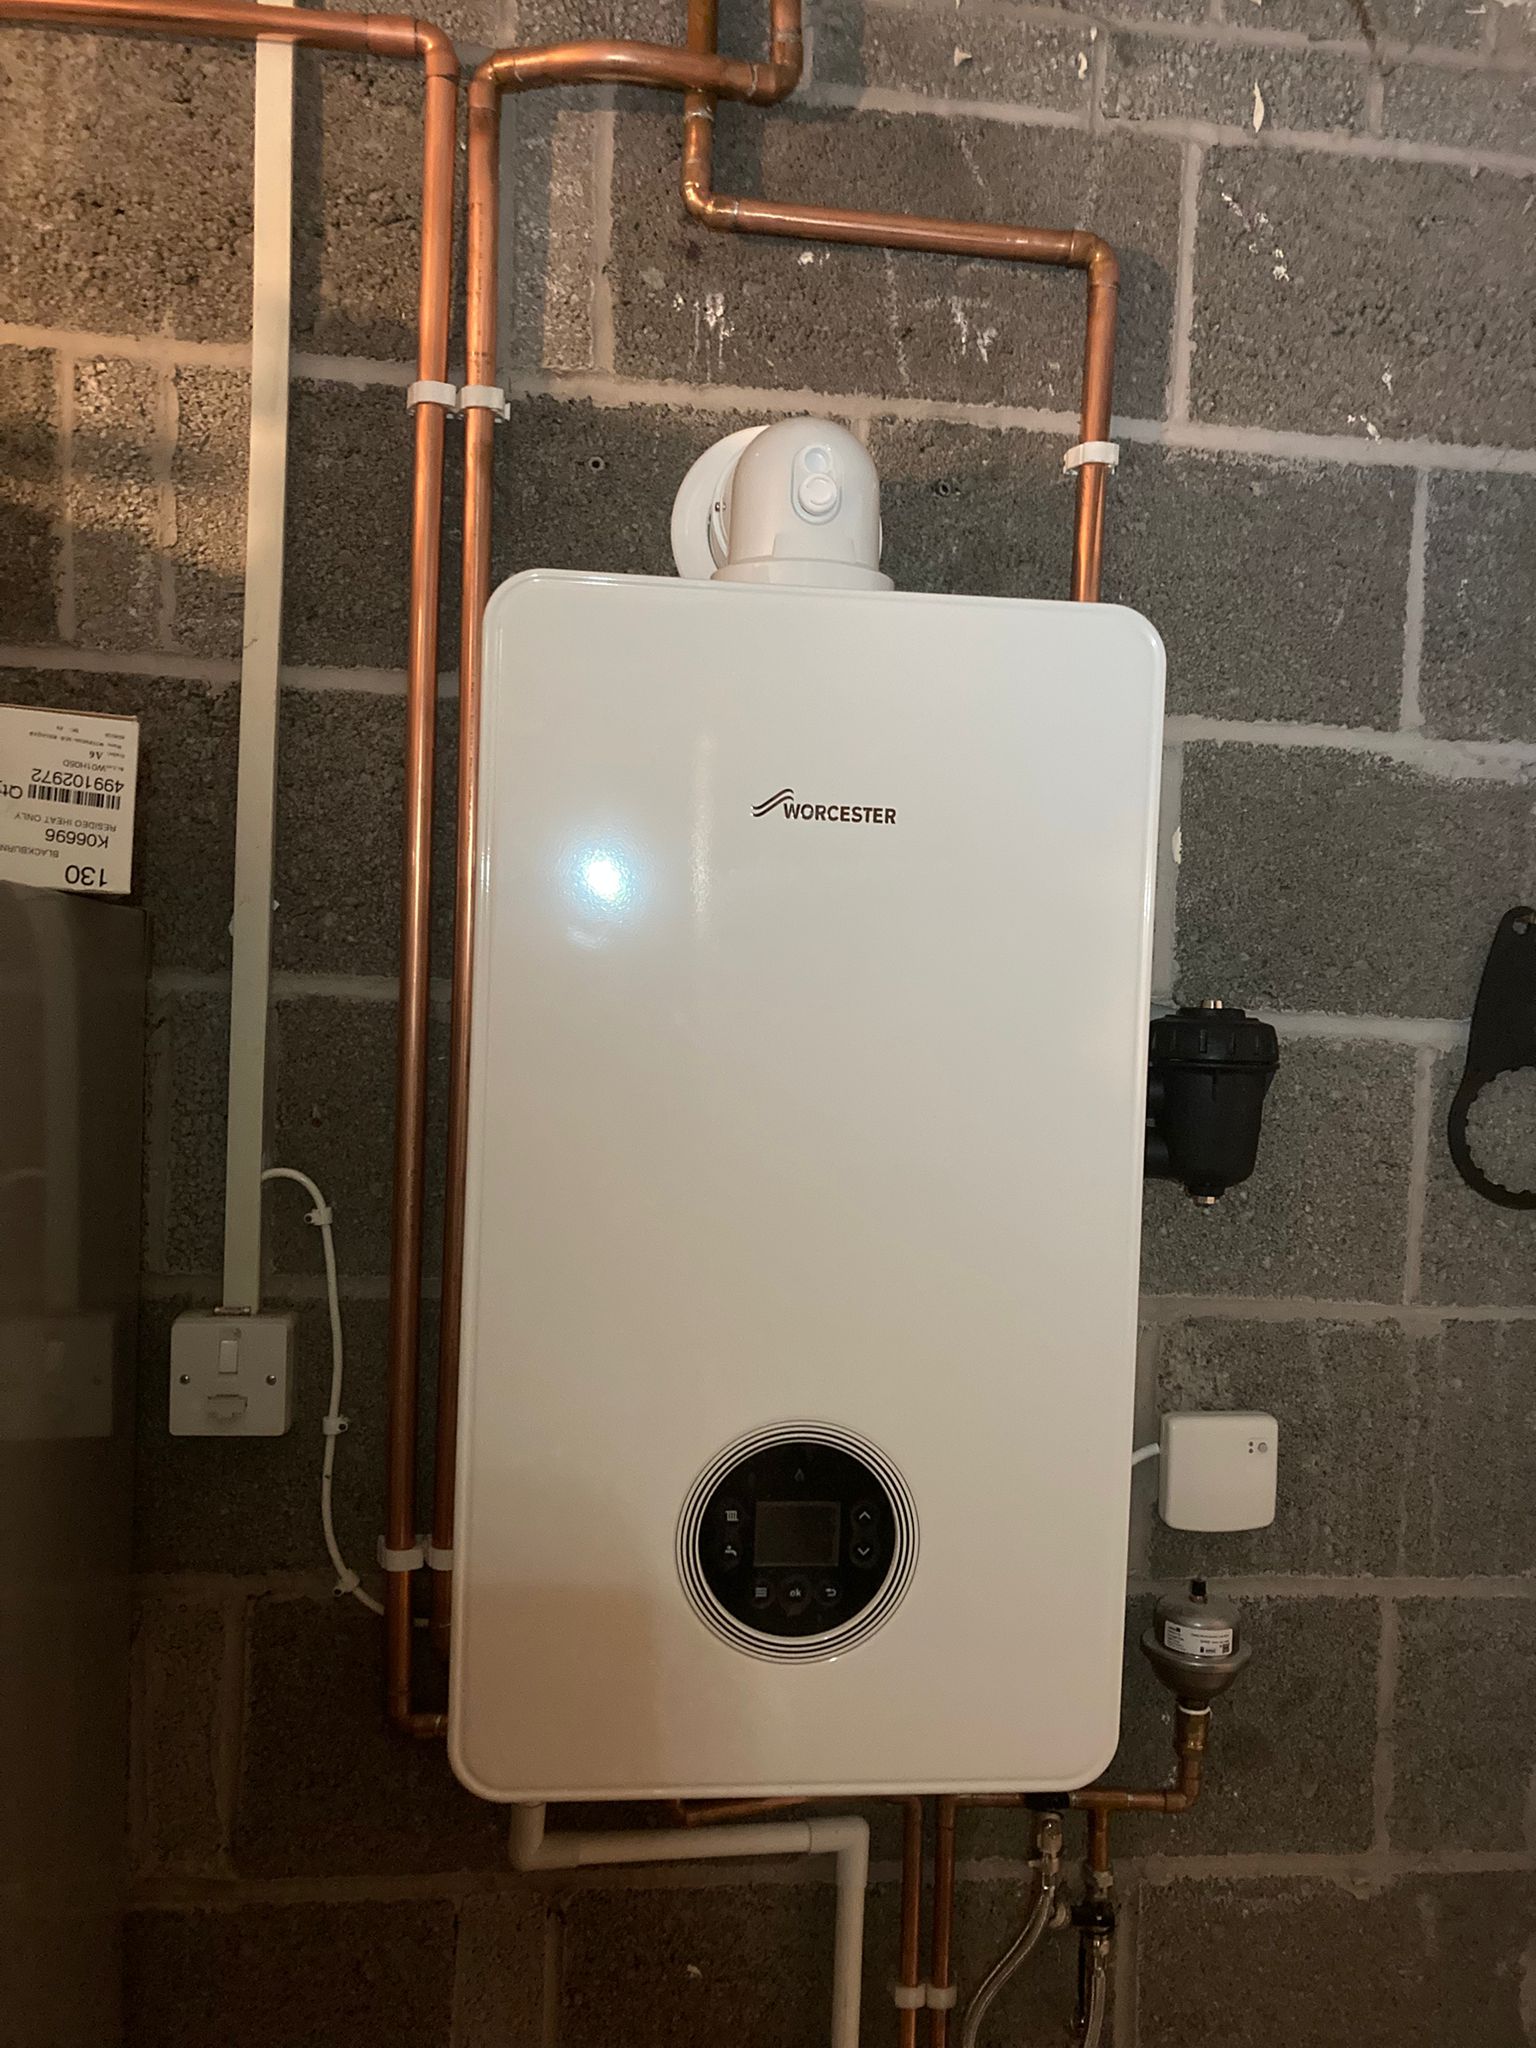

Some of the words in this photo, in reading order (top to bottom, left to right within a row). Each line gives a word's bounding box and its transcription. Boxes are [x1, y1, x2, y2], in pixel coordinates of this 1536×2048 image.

[89, 750, 104, 760] A6
[31, 768, 124, 793] 499102972
[14, 812, 42, 823] ONLY
[783, 803, 896, 824] WORCESTER
[74, 819, 117, 832] RESIDEO
[45, 828, 109, 849] K06696
[65, 865, 108, 888] 130
